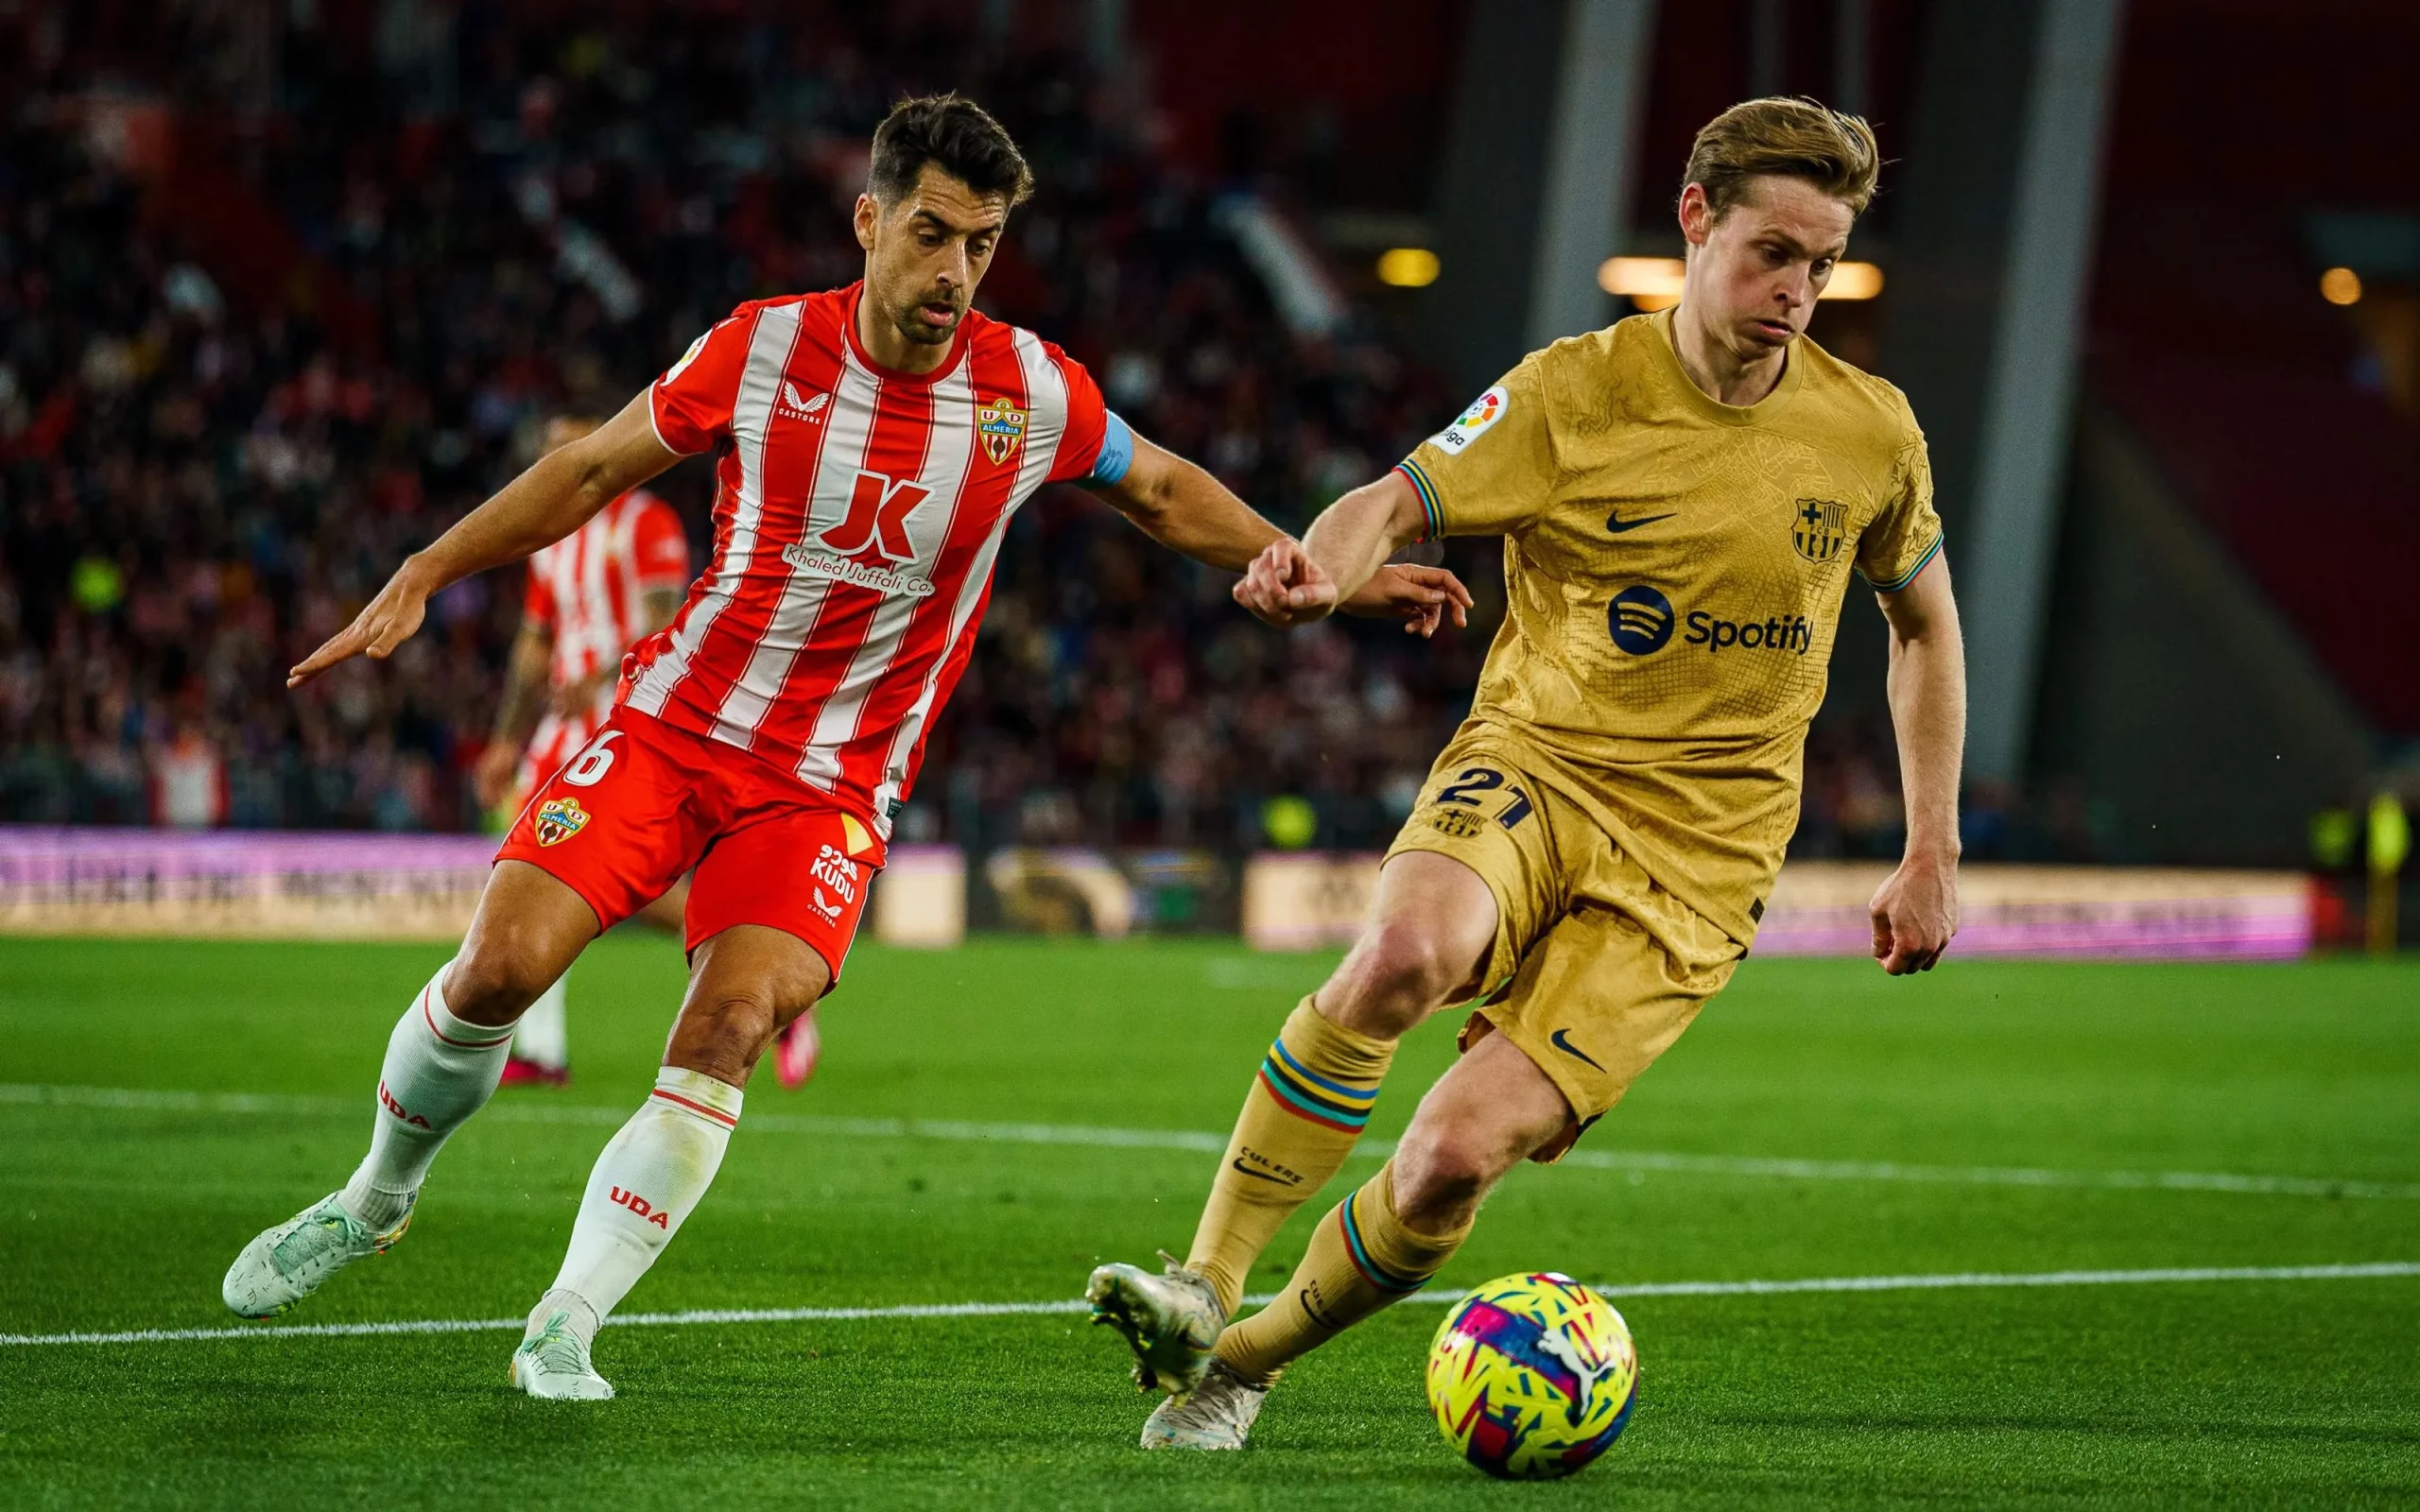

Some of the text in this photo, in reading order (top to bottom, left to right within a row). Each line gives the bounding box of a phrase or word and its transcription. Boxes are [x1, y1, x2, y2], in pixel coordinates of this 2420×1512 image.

[778, 407, 821, 424] CASTORE
[982, 424, 1020, 435] ALMERIA
[817, 471, 933, 561] JK
[1810, 525, 1829, 537] FCB
[786, 546, 932, 593] Khaled Juffali Co.
[1684, 610, 1813, 656] Spotify
[563, 729, 625, 787] 6
[1435, 767, 1533, 831] 21
[541, 814, 577, 831] ALMERIA
[810, 857, 855, 904] KUDU
[806, 903, 837, 929] CASTORE
[380, 1079, 432, 1131] UDA
[1240, 1145, 1305, 1183] CULERS
[610, 1185, 668, 1230] UDA
